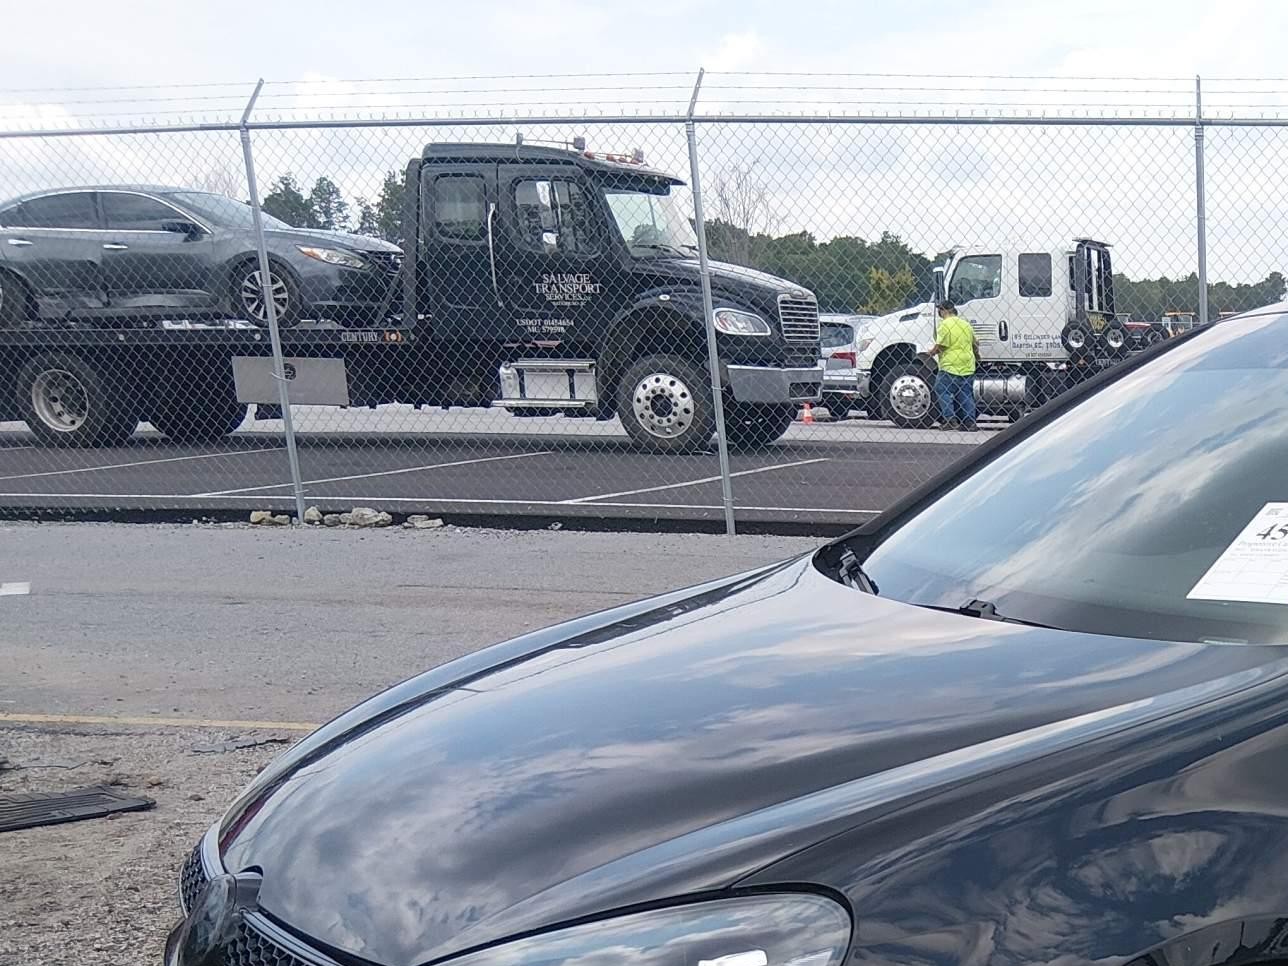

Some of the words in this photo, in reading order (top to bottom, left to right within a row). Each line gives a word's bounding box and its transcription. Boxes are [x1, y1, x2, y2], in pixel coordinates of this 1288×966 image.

[542, 273, 591, 284] SALVAGE
[534, 283, 602, 294] TRANSPORT
[341, 331, 378, 342] CENTURY
